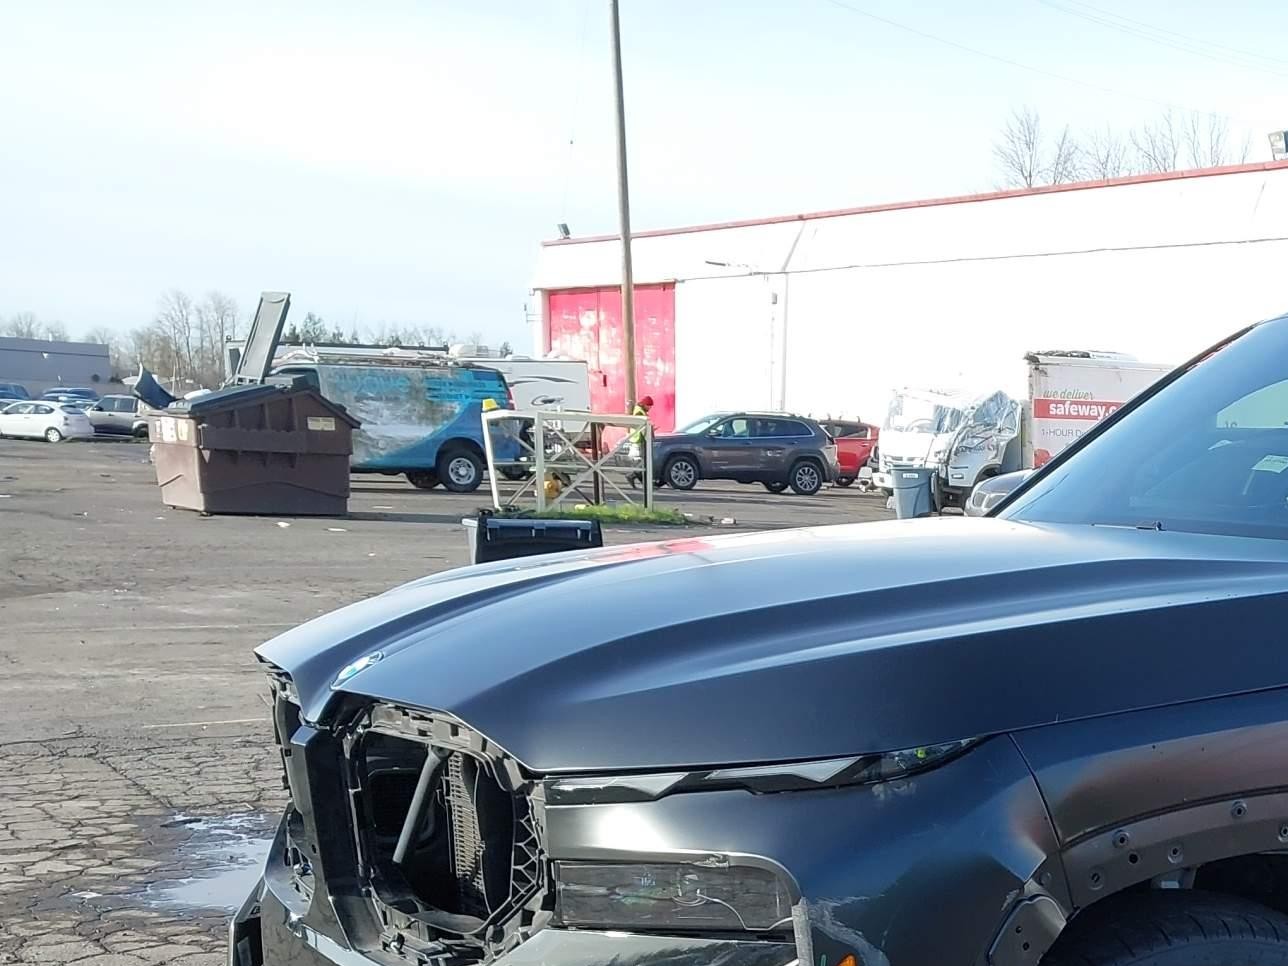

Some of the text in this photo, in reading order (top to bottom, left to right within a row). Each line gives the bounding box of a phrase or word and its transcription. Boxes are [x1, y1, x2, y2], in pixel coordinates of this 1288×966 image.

[1043, 388, 1095, 400] we deliver
[1049, 401, 1117, 421] safeway.c
[1041, 428, 1074, 438] 1-HOUR
